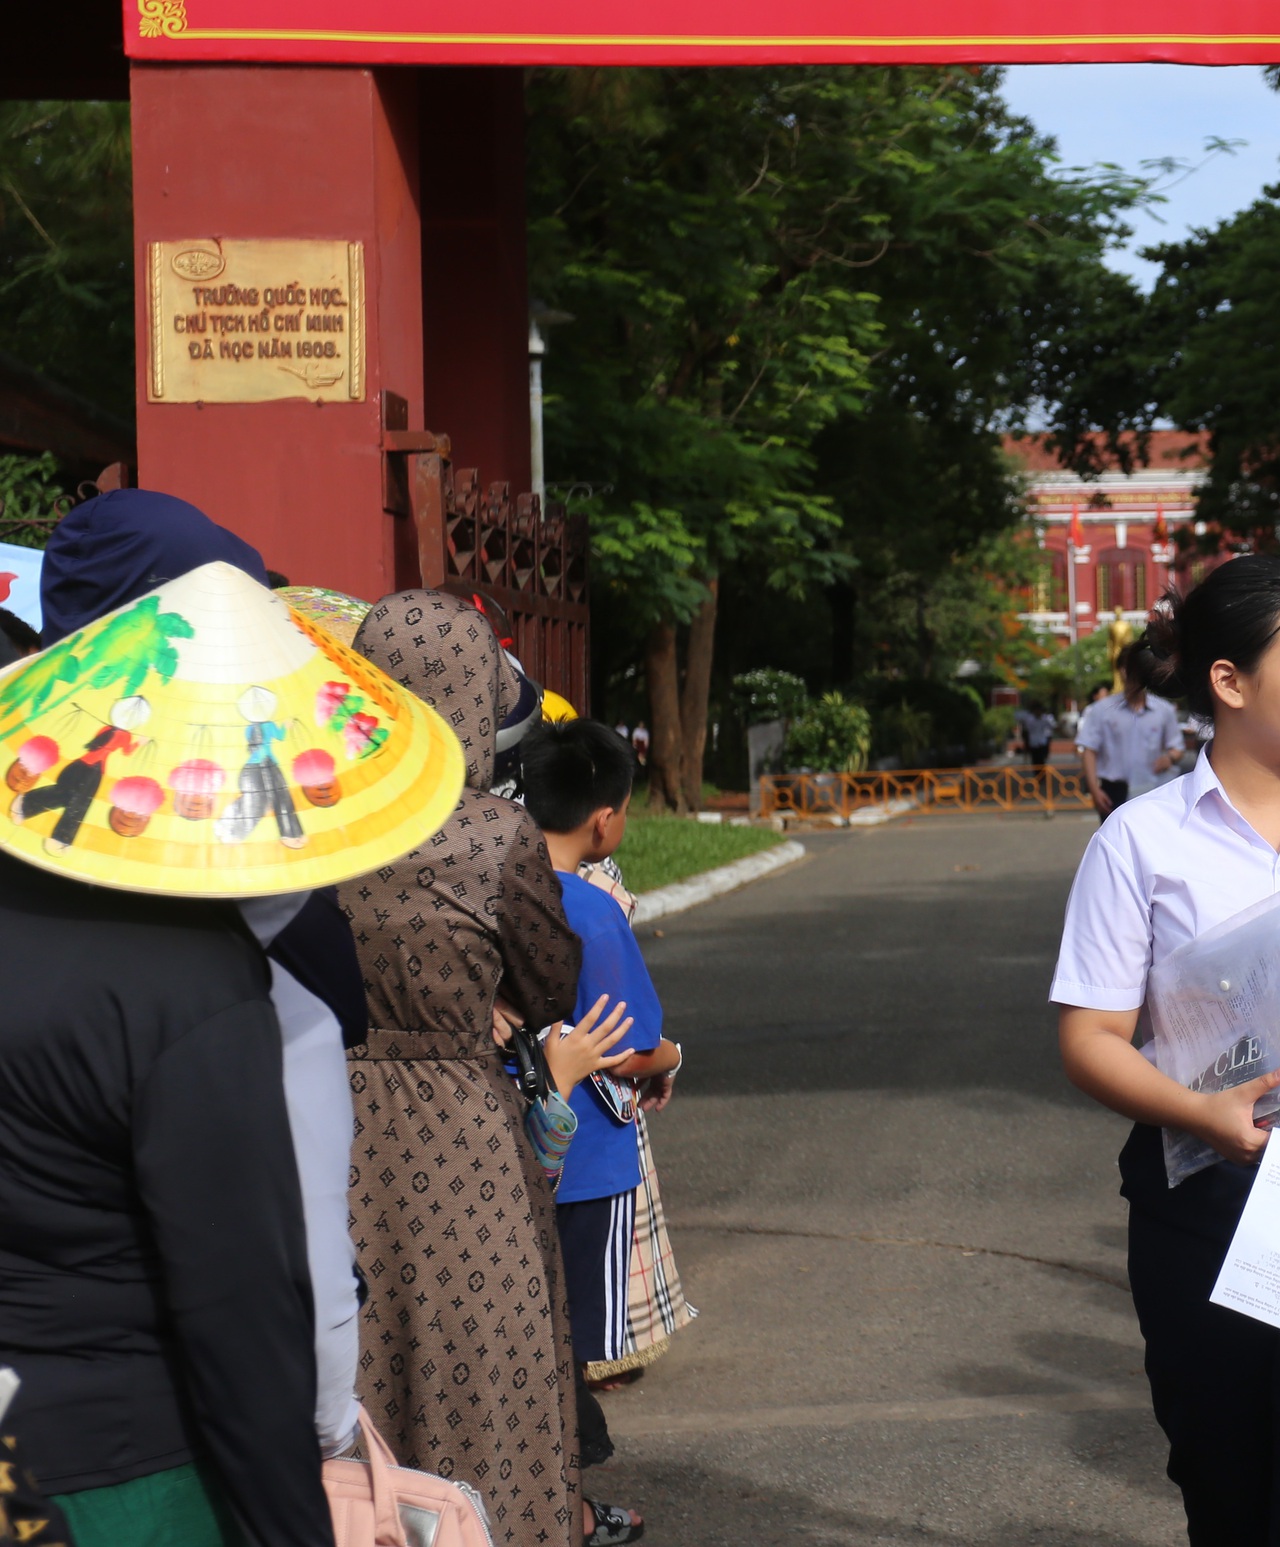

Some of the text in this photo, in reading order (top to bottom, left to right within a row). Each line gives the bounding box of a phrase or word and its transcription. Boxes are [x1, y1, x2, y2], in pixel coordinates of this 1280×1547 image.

[263, 281, 306, 308] QUỐC
[210, 314, 245, 336] TỊCH
[248, 308, 270, 333] HỒ
[274, 309, 304, 333] CHÍ
[306, 314, 344, 333] MINH
[188, 338, 215, 360] ĐÃ
[219, 341, 254, 362] HỌC
[258, 337, 292, 359] NĂM
